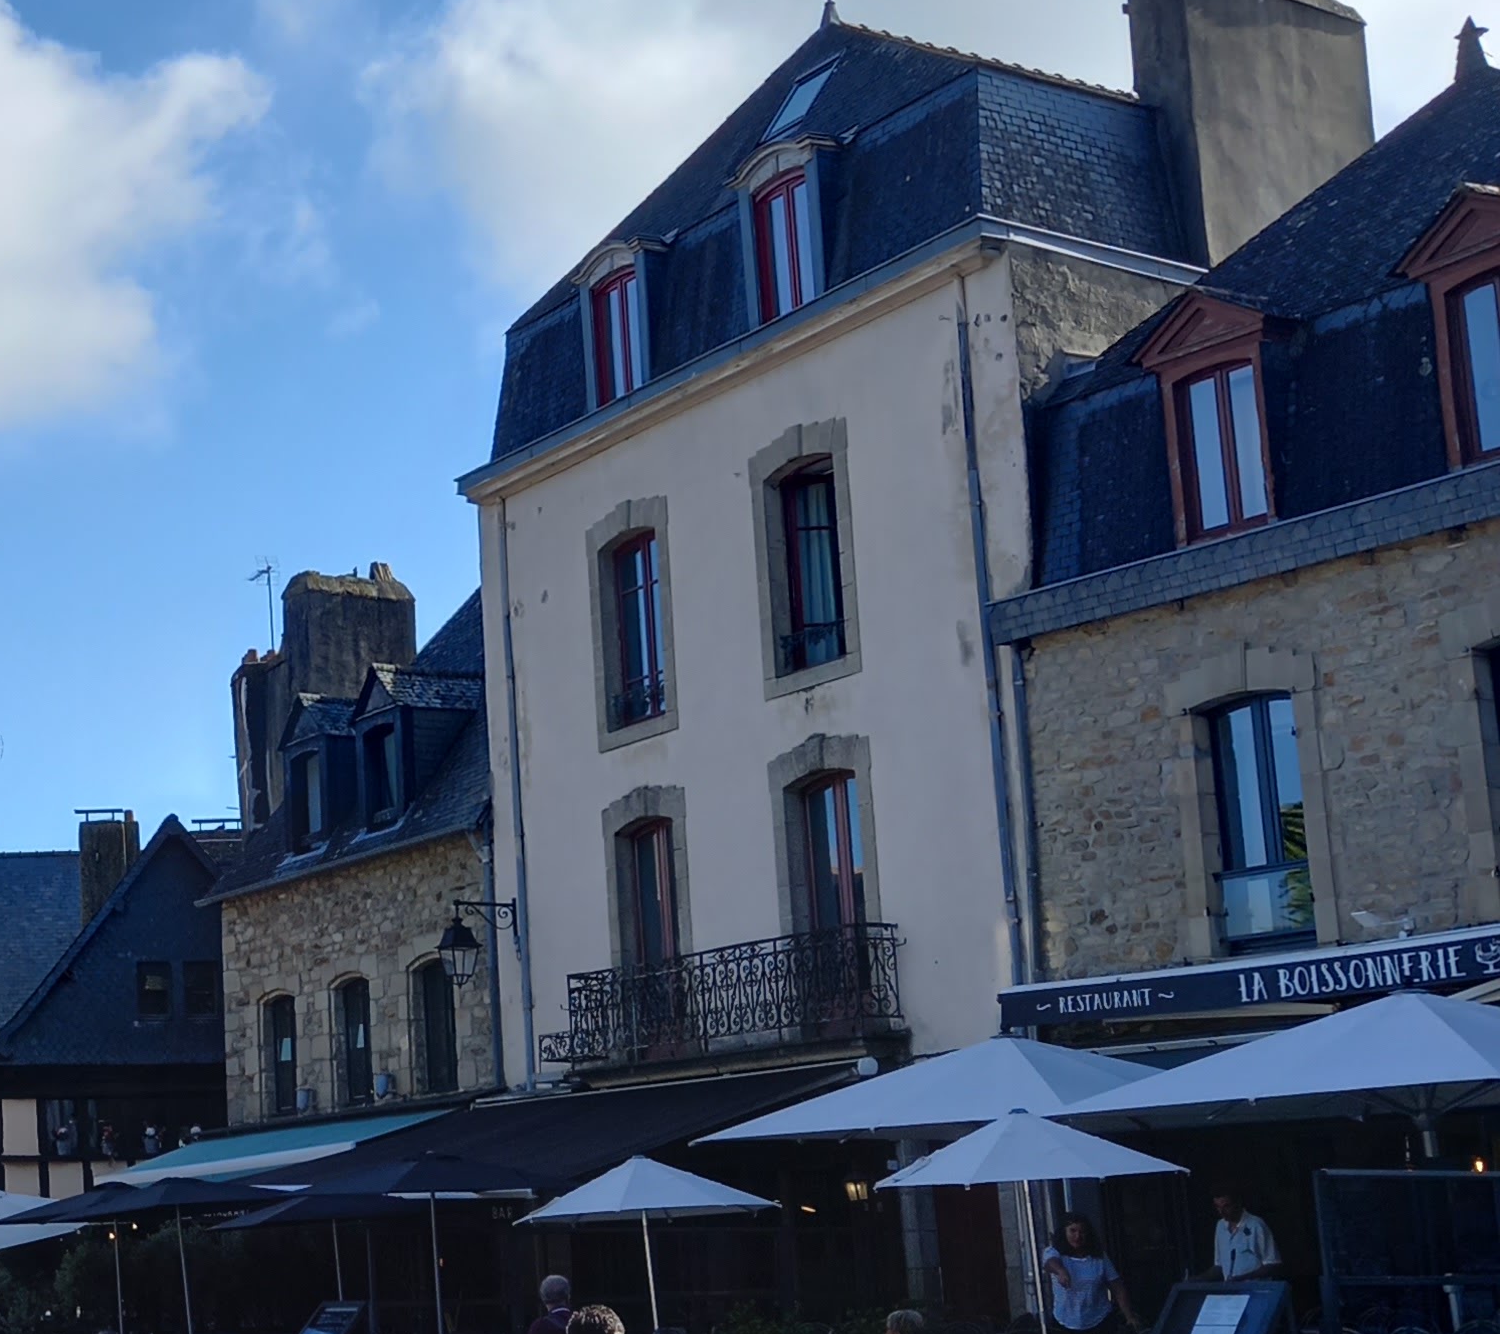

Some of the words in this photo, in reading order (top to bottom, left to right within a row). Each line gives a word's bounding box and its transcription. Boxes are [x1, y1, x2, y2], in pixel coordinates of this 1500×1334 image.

[1238, 971, 1268, 1003] LA
[1277, 945, 1467, 998] BOISSONNERIE
[1058, 988, 1152, 1014] RESTAURANT
